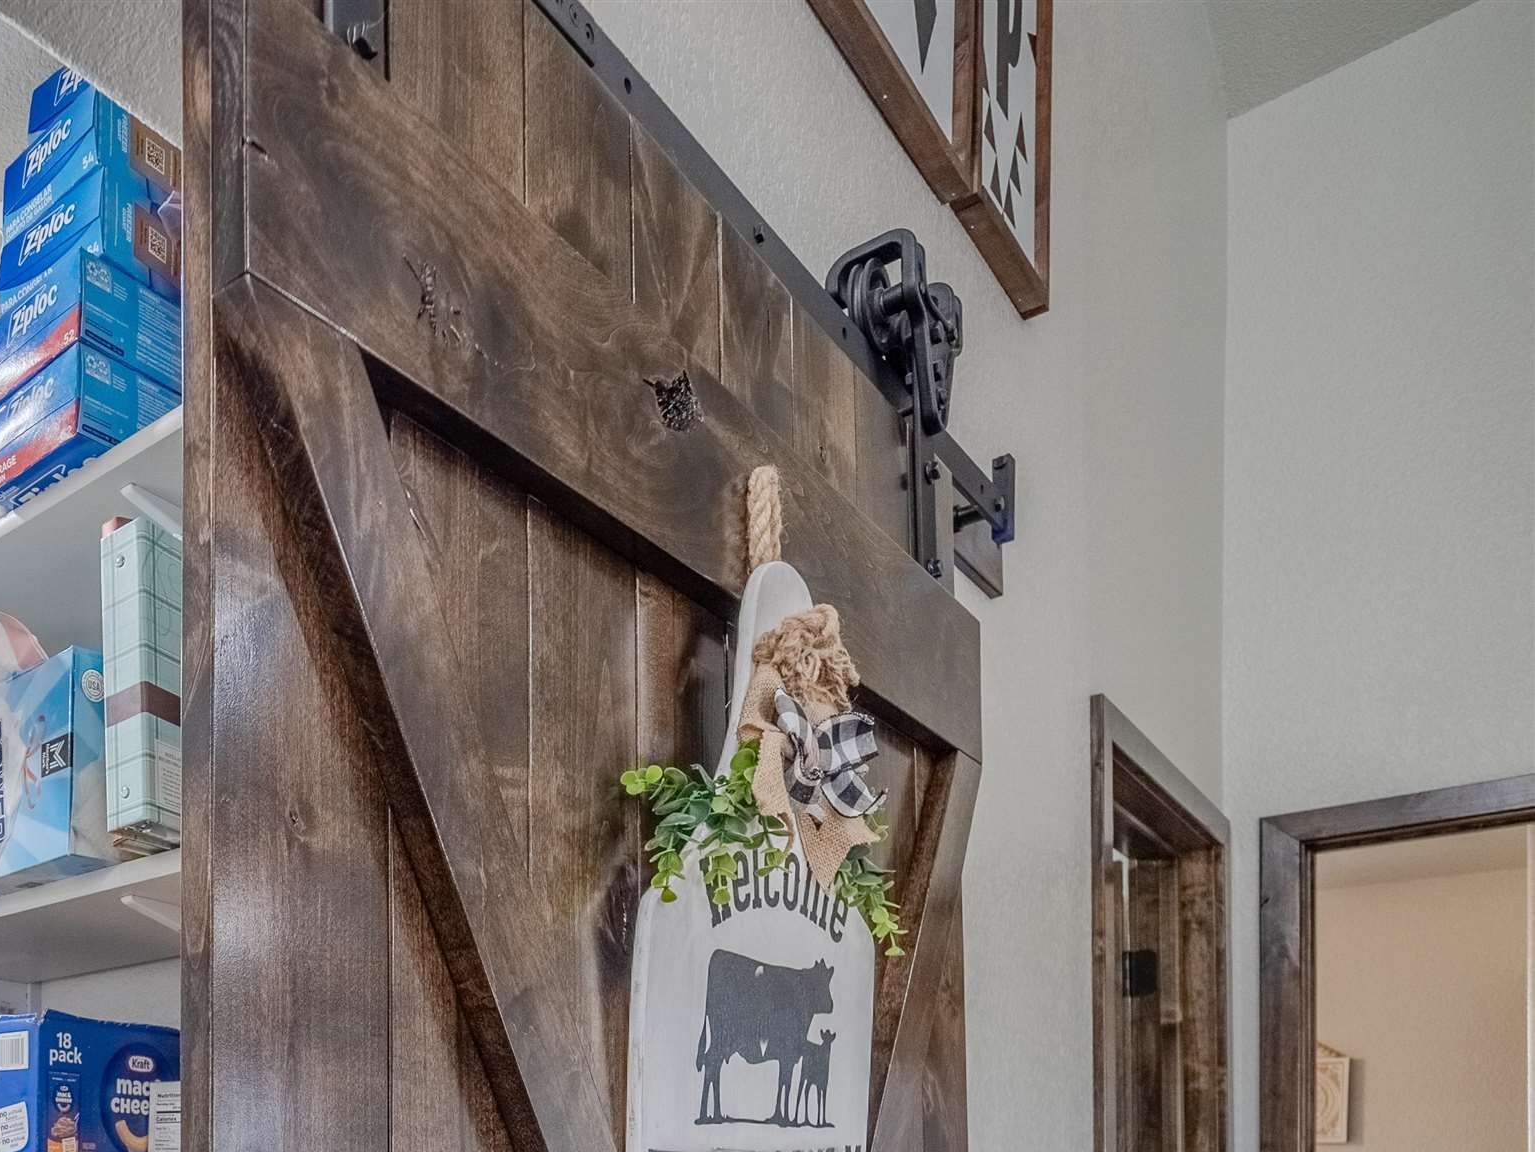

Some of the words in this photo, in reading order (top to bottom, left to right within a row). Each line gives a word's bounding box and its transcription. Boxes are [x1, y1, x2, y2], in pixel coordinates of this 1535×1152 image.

[59, 66, 84, 94] Zip
[26, 118, 72, 177] Ziploc
[82, 153, 96, 171] 54
[20, 184, 52, 224] CONGELAR
[25, 203, 75, 252] Ziploc
[10, 285, 58, 338] Ziploc
[63, 329, 76, 344] 52
[10, 378, 54, 418] Ziploc
[56, 1032, 72, 1049] 18
[49, 1047, 83, 1066] pack
[131, 1058, 151, 1071] Kraft
[116, 1078, 151, 1097] mac
[0, 1111, 8, 1119] no
[1, 1123, 9, 1131] no
